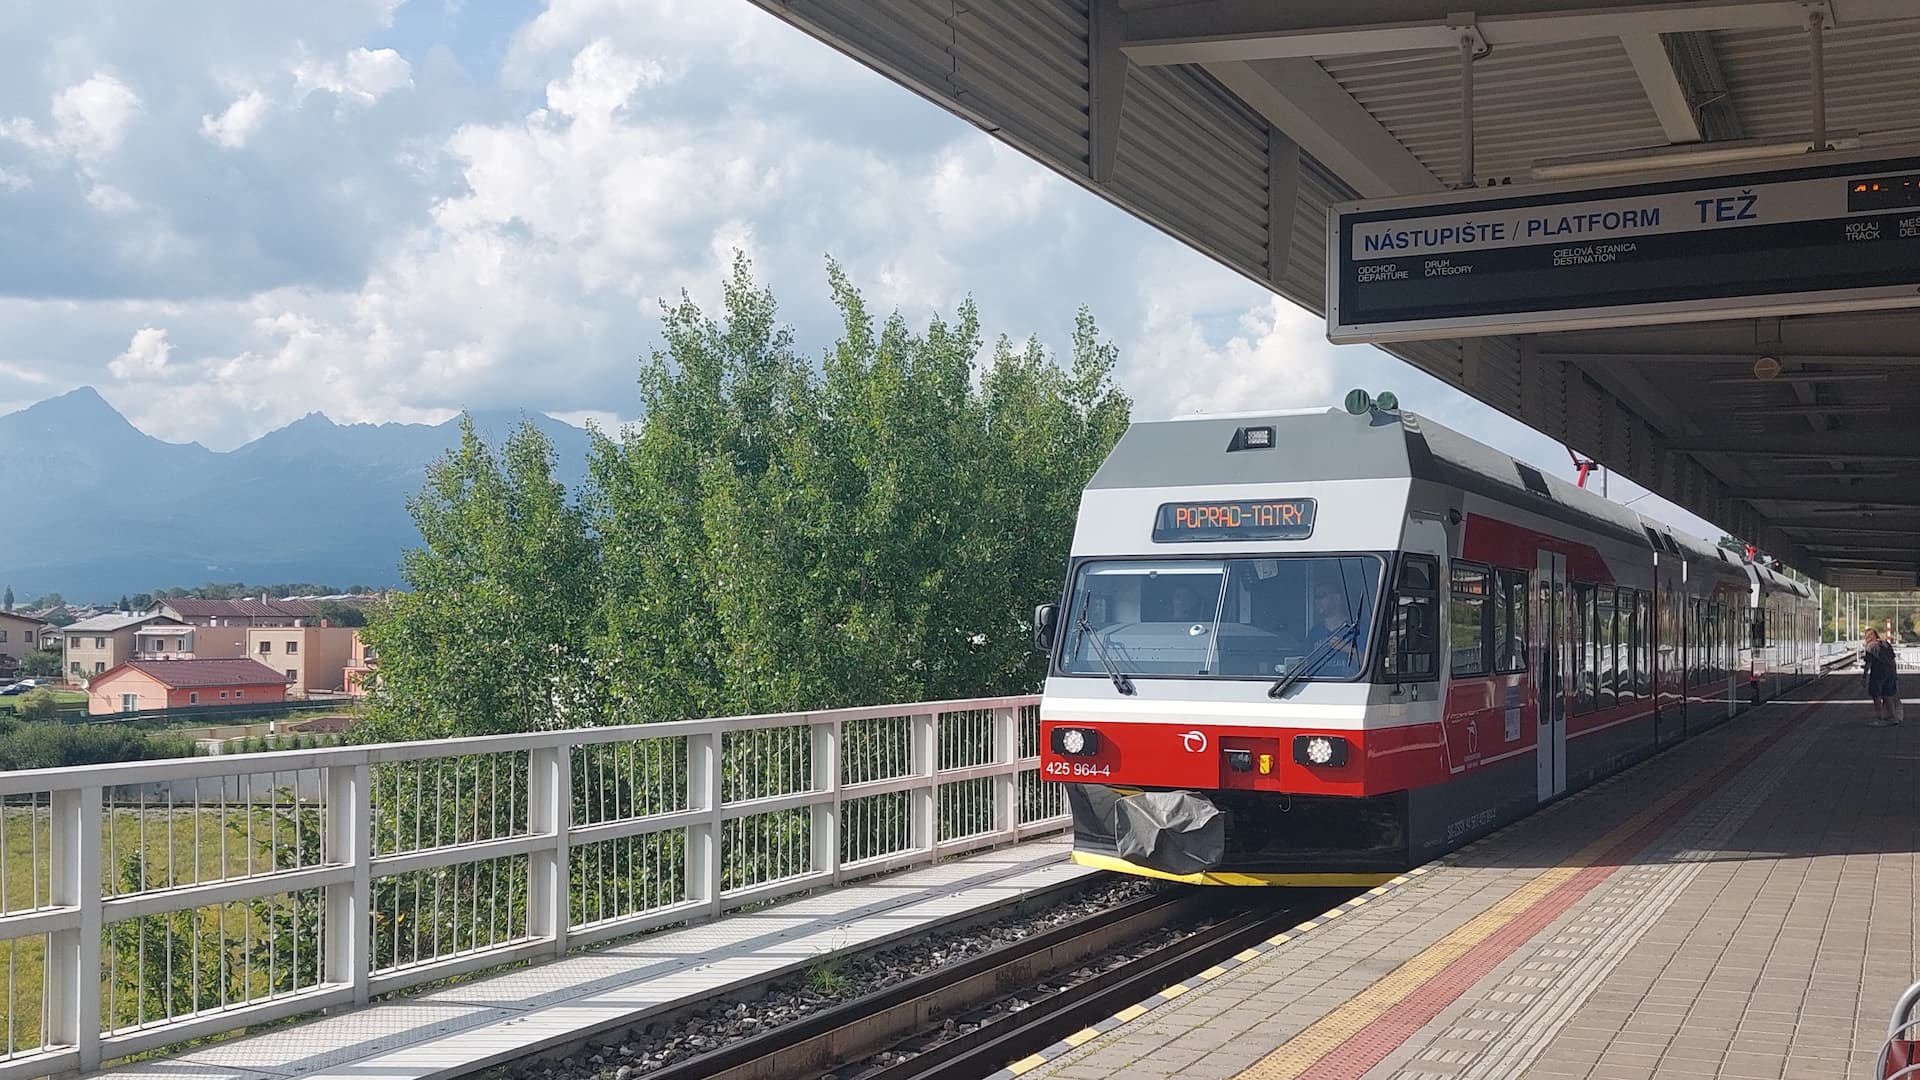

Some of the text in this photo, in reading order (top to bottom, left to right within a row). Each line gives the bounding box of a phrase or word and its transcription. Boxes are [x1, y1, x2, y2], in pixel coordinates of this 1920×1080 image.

[1365, 189, 1758, 251] NÁSTUPIŠTE / PLATFORM TEŽ
[1845, 230, 1880, 241] TRACK
[1553, 243, 1637, 258] CIELOVÁ STANICA
[1424, 260, 1450, 269] DRUH
[1553, 253, 1616, 266] DESTINATION
[1358, 264, 1396, 275] ODCHOD
[1424, 265, 1473, 277] CATEGORY
[1358, 271, 1408, 282] DEPARTURE
[1176, 504, 1304, 528] POPRAD-TATRY
[1046, 762, 1111, 777] 425 964-4
